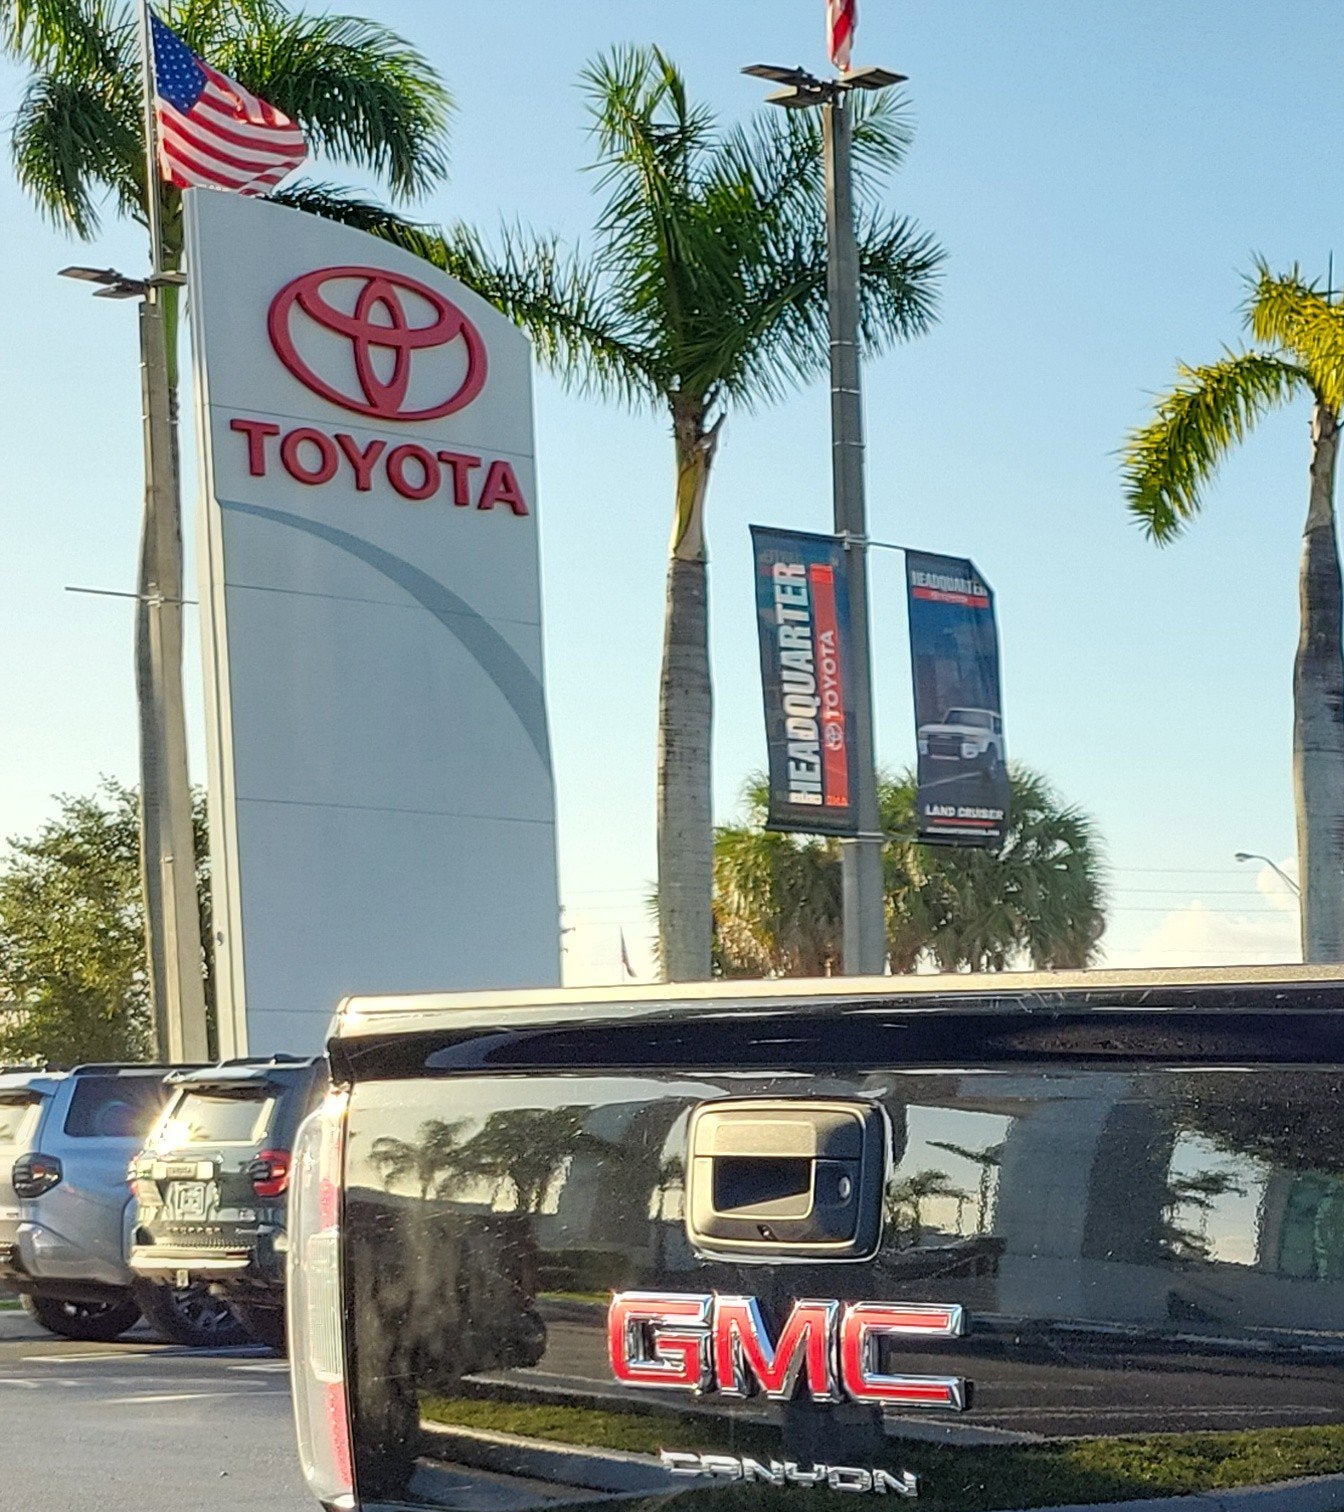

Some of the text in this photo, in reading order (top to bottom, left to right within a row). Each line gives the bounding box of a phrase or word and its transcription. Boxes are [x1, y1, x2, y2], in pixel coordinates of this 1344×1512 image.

[230, 418, 529, 517] TOYOTA
[772, 561, 823, 806] HEADQUARTER
[822, 629, 846, 720] TOYOTA
[925, 804, 955, 817] LAND
[608, 1290, 967, 1412] GMC
[660, 1447, 919, 1498] CANYON
